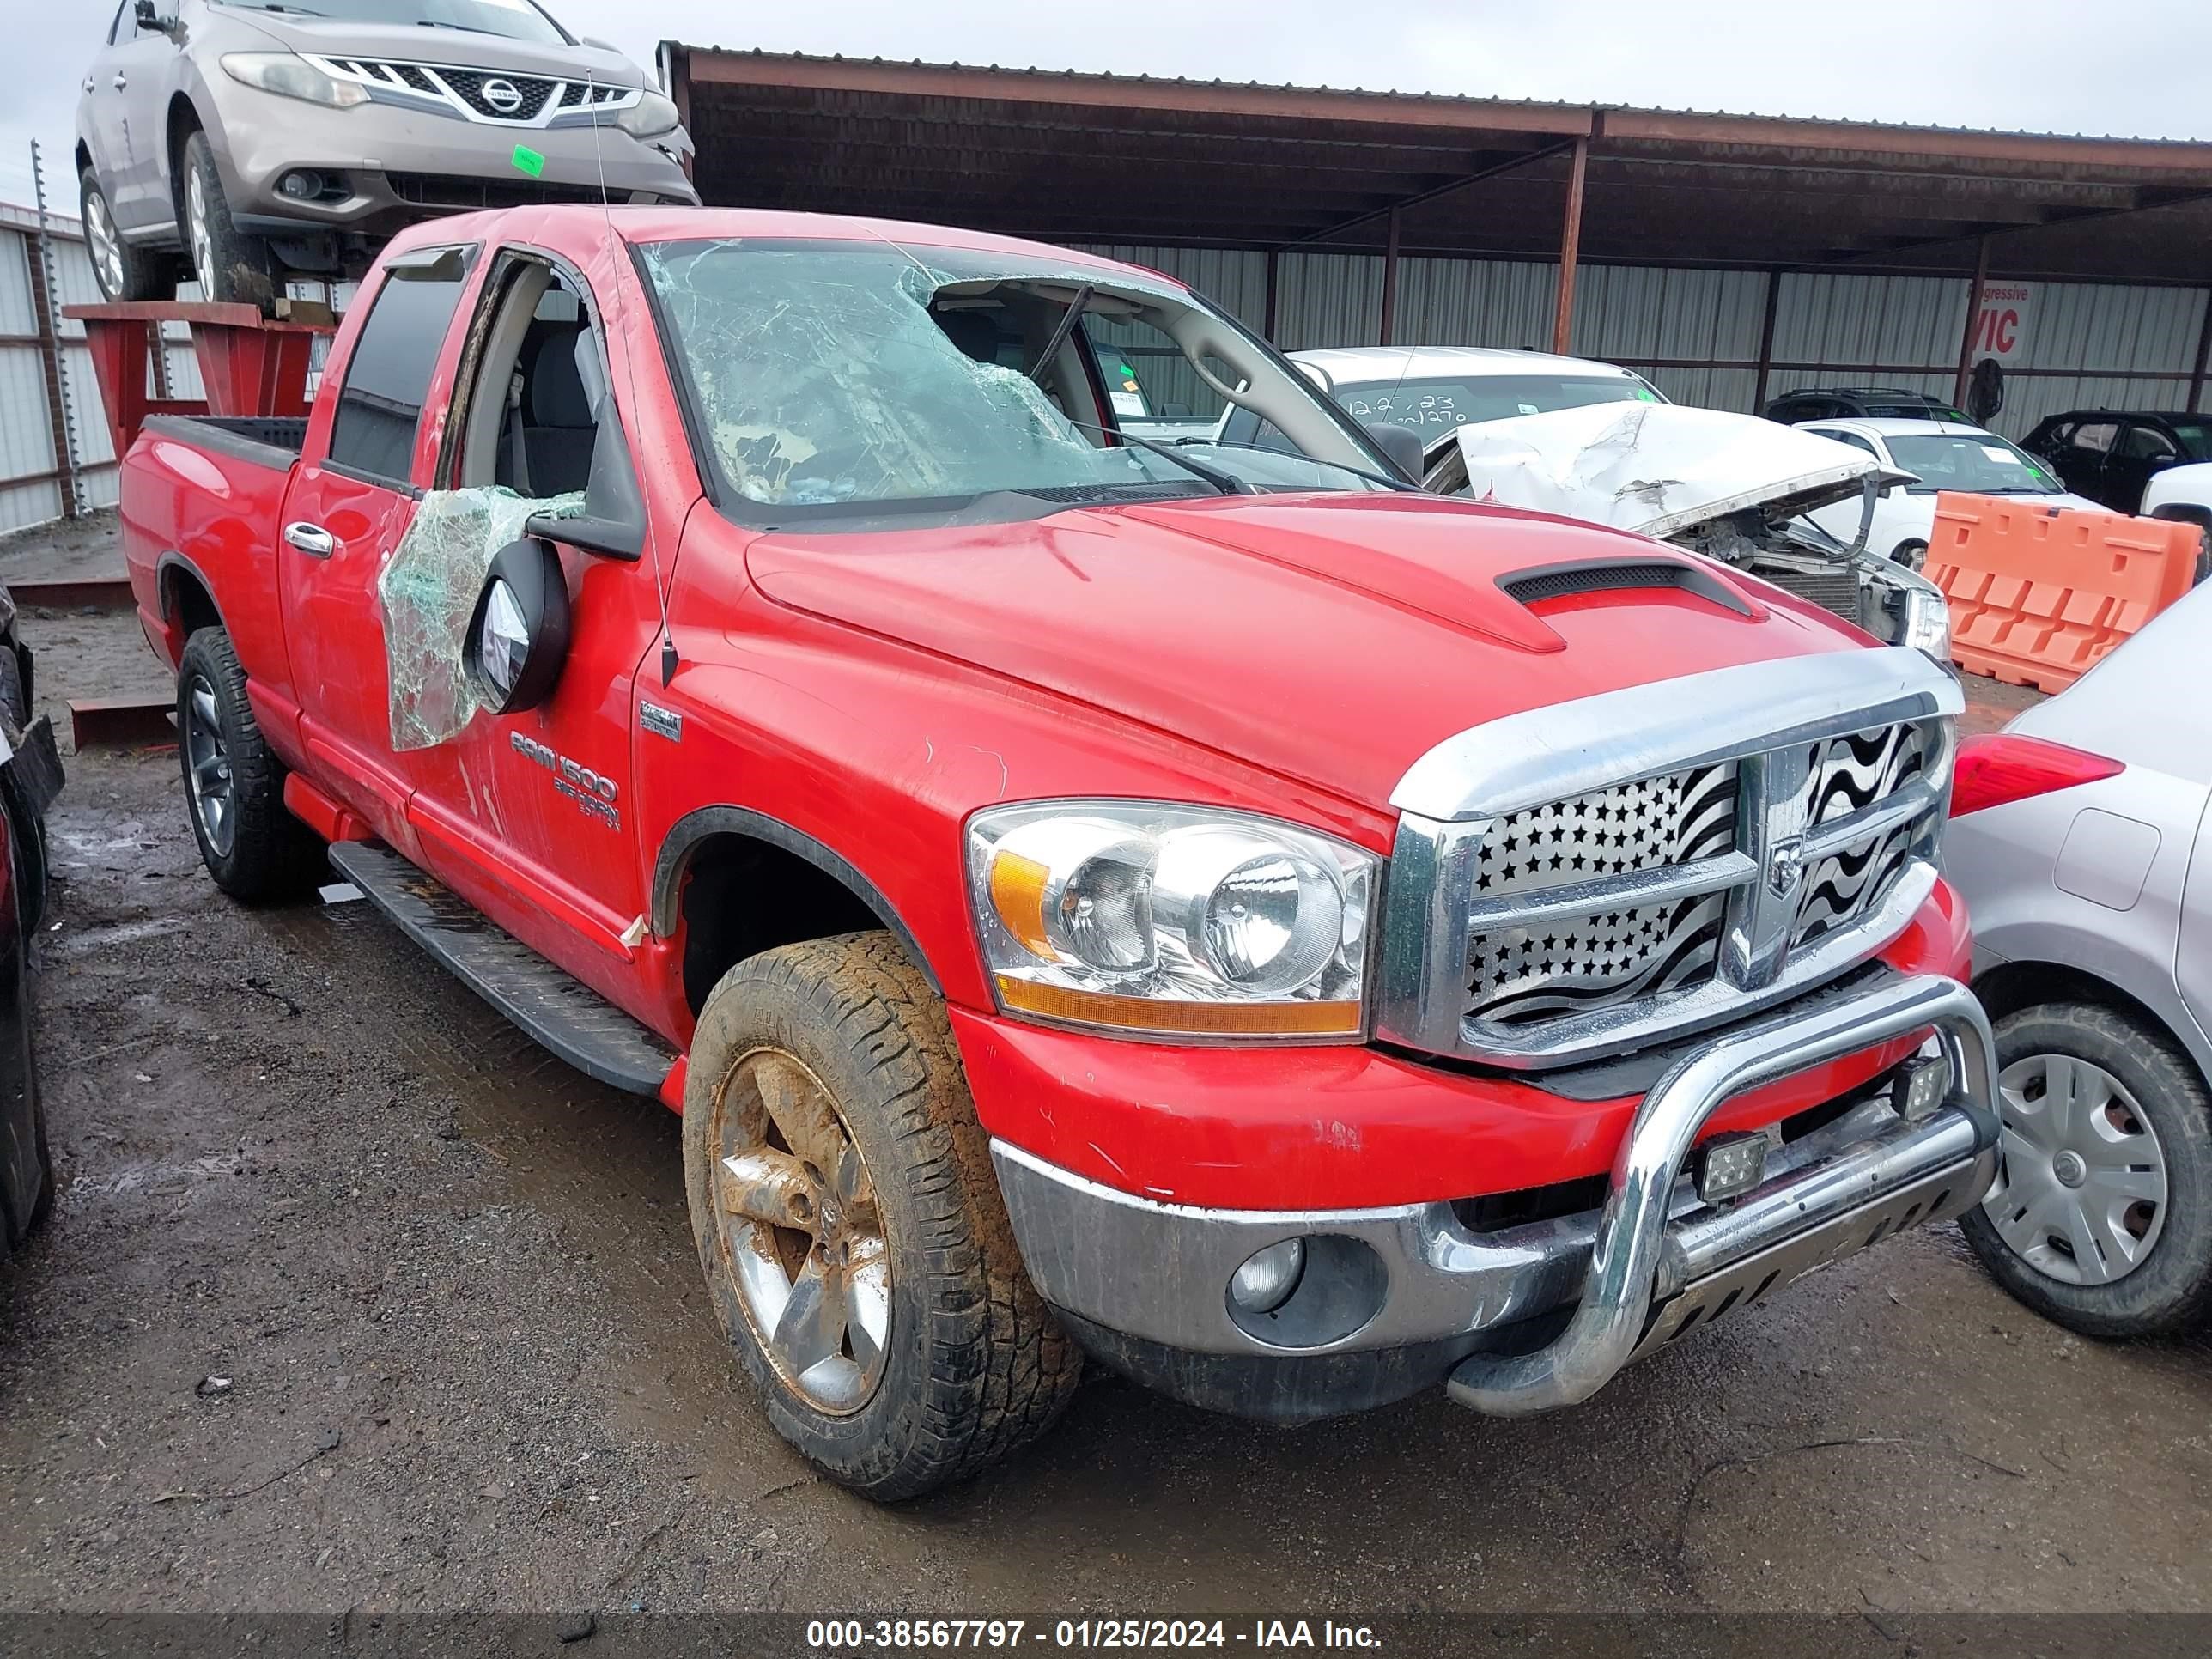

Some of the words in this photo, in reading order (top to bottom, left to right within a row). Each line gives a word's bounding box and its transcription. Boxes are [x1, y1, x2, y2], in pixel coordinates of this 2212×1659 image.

[487, 90, 520, 99] NISSAN
[510, 730, 556, 772] RAM
[560, 755, 618, 802] 1500
